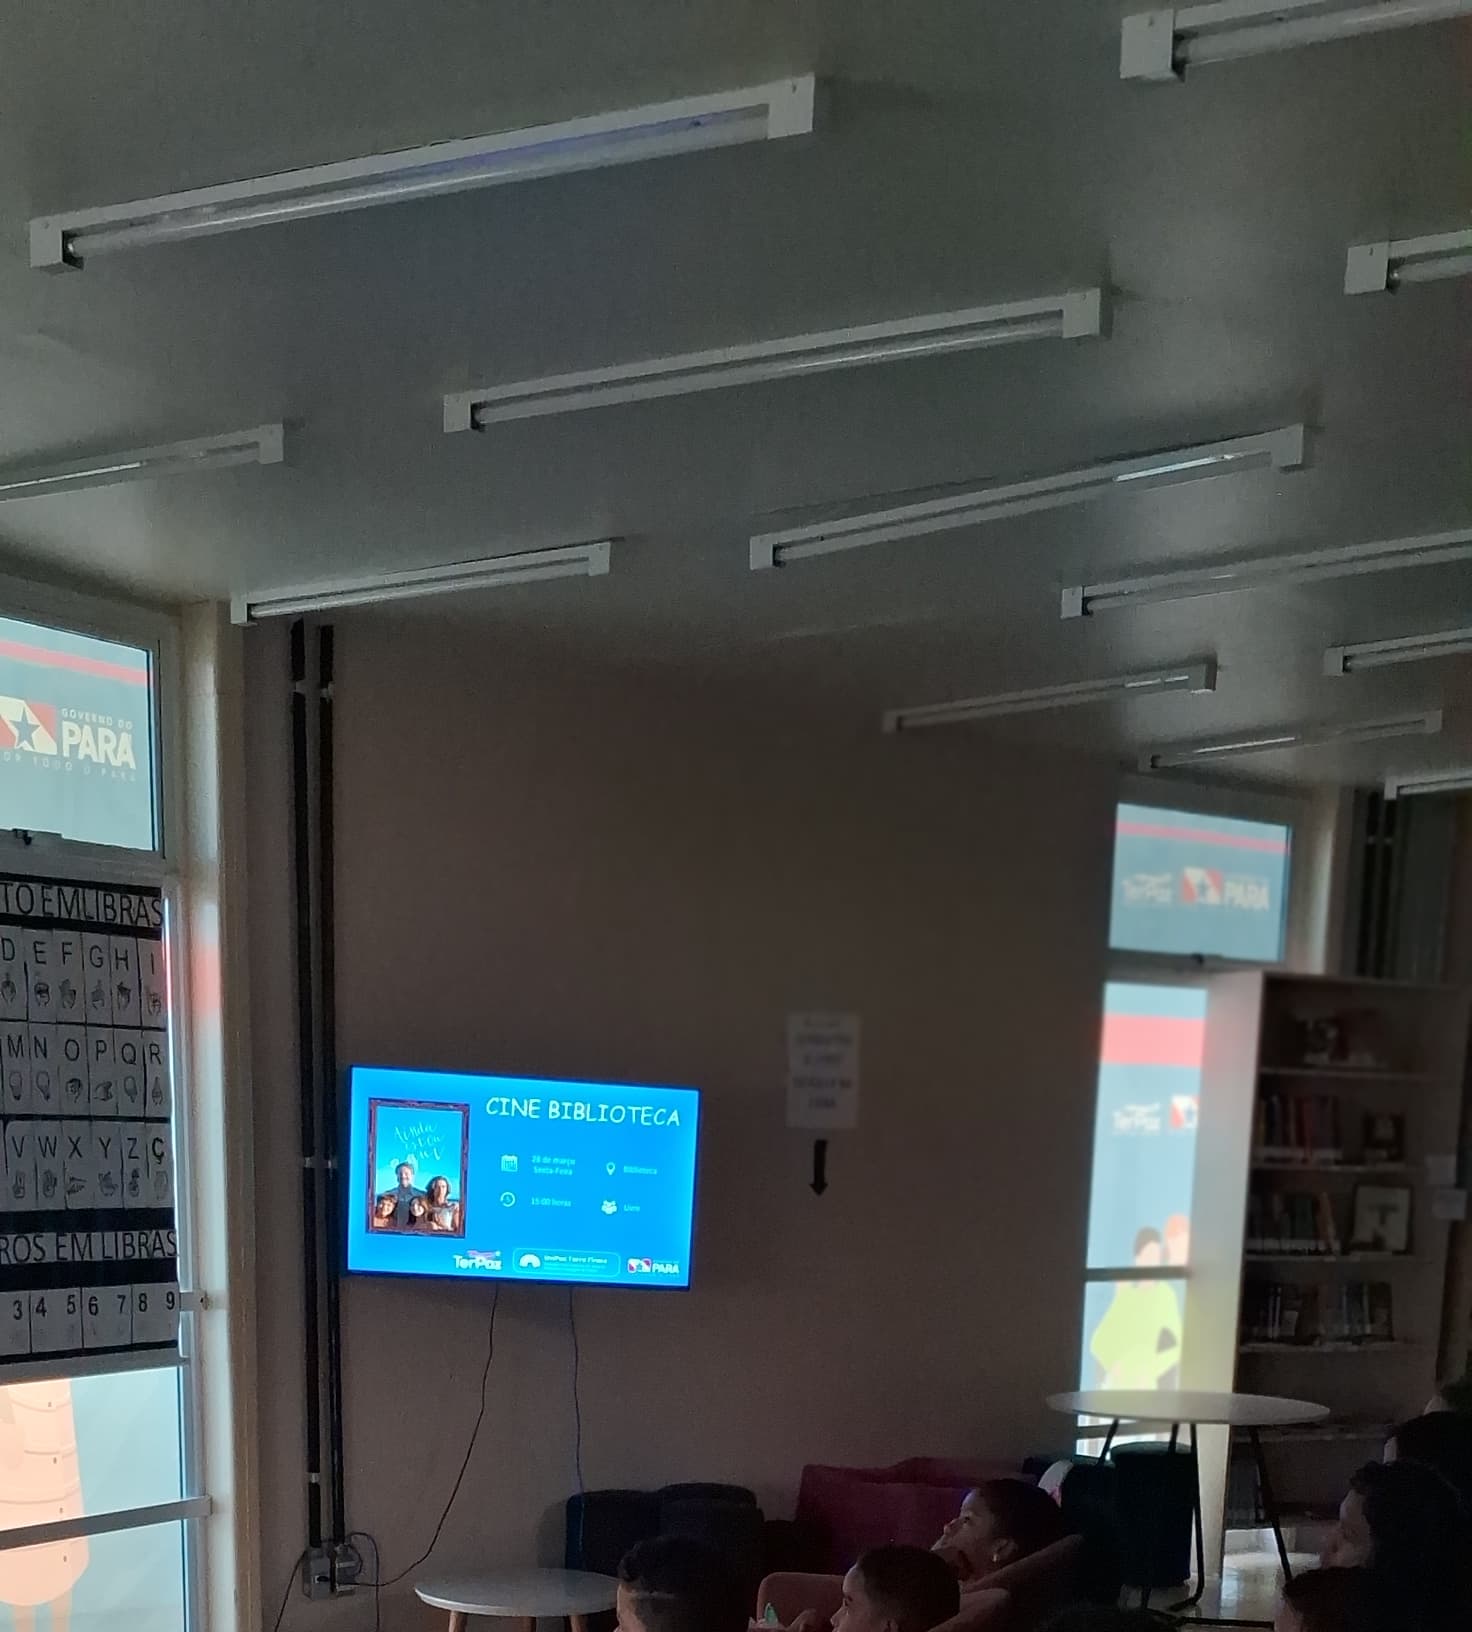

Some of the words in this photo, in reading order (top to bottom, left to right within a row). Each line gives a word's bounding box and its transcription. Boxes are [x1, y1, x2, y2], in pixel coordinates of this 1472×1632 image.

[1, 937, 16, 961] D
[33, 940, 47, 965] E
[61, 941, 73, 965] F
[89, 945, 104, 968] G
[115, 947, 129, 971] H
[150, 952, 156, 975] I
[7, 1034, 24, 1059] M
[34, 1035, 48, 1059] N
[64, 1038, 80, 1061] O
[95, 1039, 107, 1062] P
[121, 1042, 137, 1066] Q
[149, 1043, 162, 1065] R
[486, 1096, 541, 1119] CINE
[548, 1099, 681, 1127] BIBLIOTECA
[11, 1135, 25, 1159] V
[38, 1135, 57, 1159] W
[68, 1136, 82, 1159] X
[98, 1136, 112, 1159] Y
[127, 1137, 140, 1160] Z
[152, 1136, 165, 1165] Ç
[55, 1232, 93, 1261] EM
[102, 1230, 178, 1261] LIBRAS
[12, 1300, 23, 1321] 3
[35, 1296, 48, 1318] 4
[66, 1294, 77, 1315] 5
[88, 1296, 99, 1316] 6
[117, 1294, 127, 1314] 7
[138, 1293, 148, 1312] 8
[165, 1291, 175, 1311] 9
